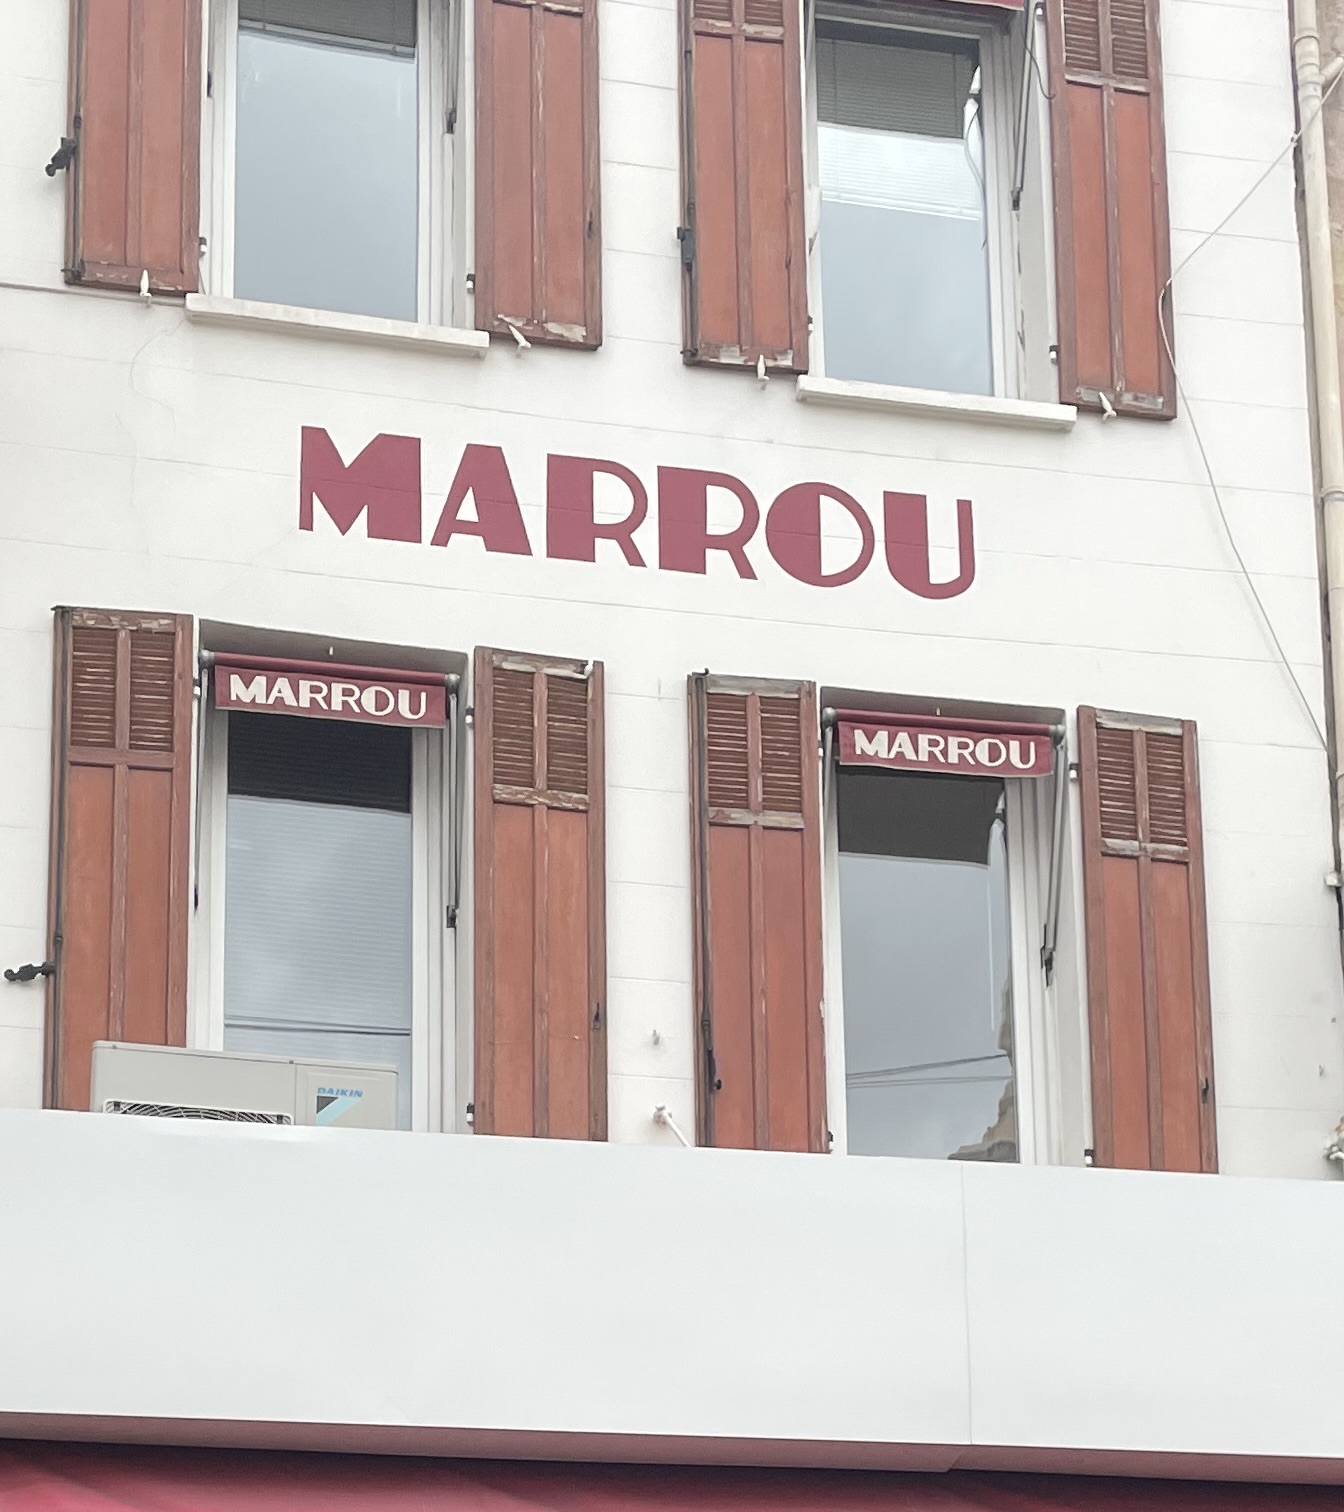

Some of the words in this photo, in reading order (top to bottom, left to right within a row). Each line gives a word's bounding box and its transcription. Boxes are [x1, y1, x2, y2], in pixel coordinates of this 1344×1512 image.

[298, 424, 976, 600] MARROU
[228, 673, 429, 721] MARROU
[852, 728, 1037, 770] MARROU
[316, 1086, 364, 1098] DAIKIN
